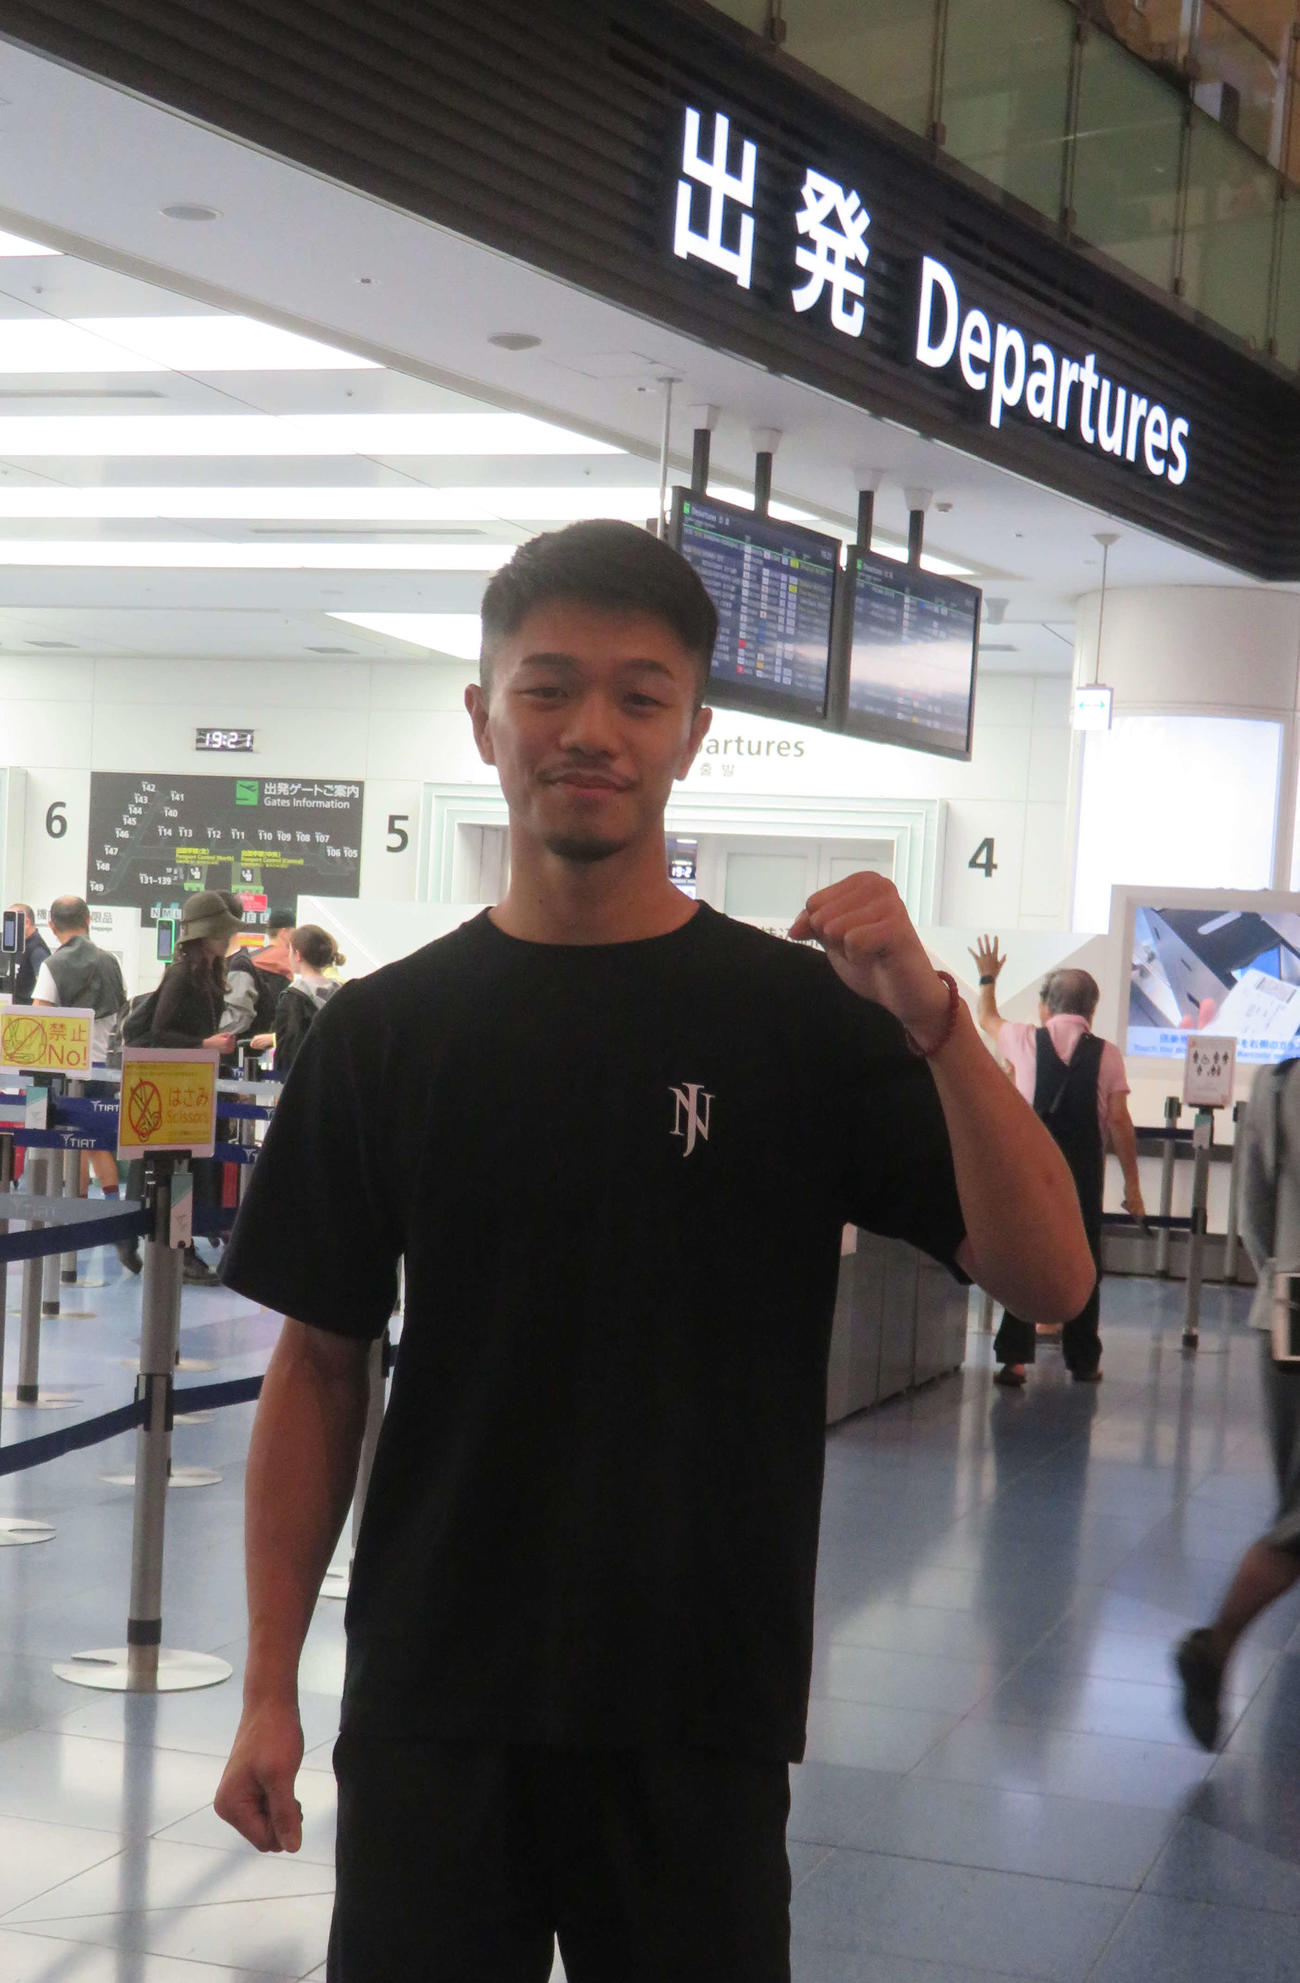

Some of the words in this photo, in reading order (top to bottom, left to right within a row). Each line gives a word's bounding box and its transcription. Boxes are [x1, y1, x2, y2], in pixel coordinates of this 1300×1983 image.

[673, 106, 871, 338] 出発
[916, 256, 1190, 486] Departures
[206, 731, 252, 749] 19:21
[699, 736, 805, 758] artures
[142, 784, 156, 793] 142
[264, 782, 360, 799] 出発ゲートご案内
[171, 793, 184, 802] 141
[264, 797, 291, 807] Gates
[293, 798, 350, 809] Information
[129, 807, 142, 815] 144
[164, 809, 178, 818] 140
[45, 801, 68, 839] 6
[123, 817, 137, 826] 145
[158, 828, 172, 837] 114
[179, 829, 193, 838] 113
[208, 830, 222, 839] 112
[231, 831, 245, 840] 111
[259, 832, 273, 841] 110
[386, 814, 410, 853] 5
[315, 835, 330, 844] 107
[105, 847, 118, 856] 147
[344, 849, 358, 858] 105
[968, 837, 998, 878] 4
[49, 1023, 87, 1042] 禁止
[48, 1044, 87, 1066] No!
[168, 1087, 209, 1107] はさみ
[70, 1138, 96, 1148] TIAT
